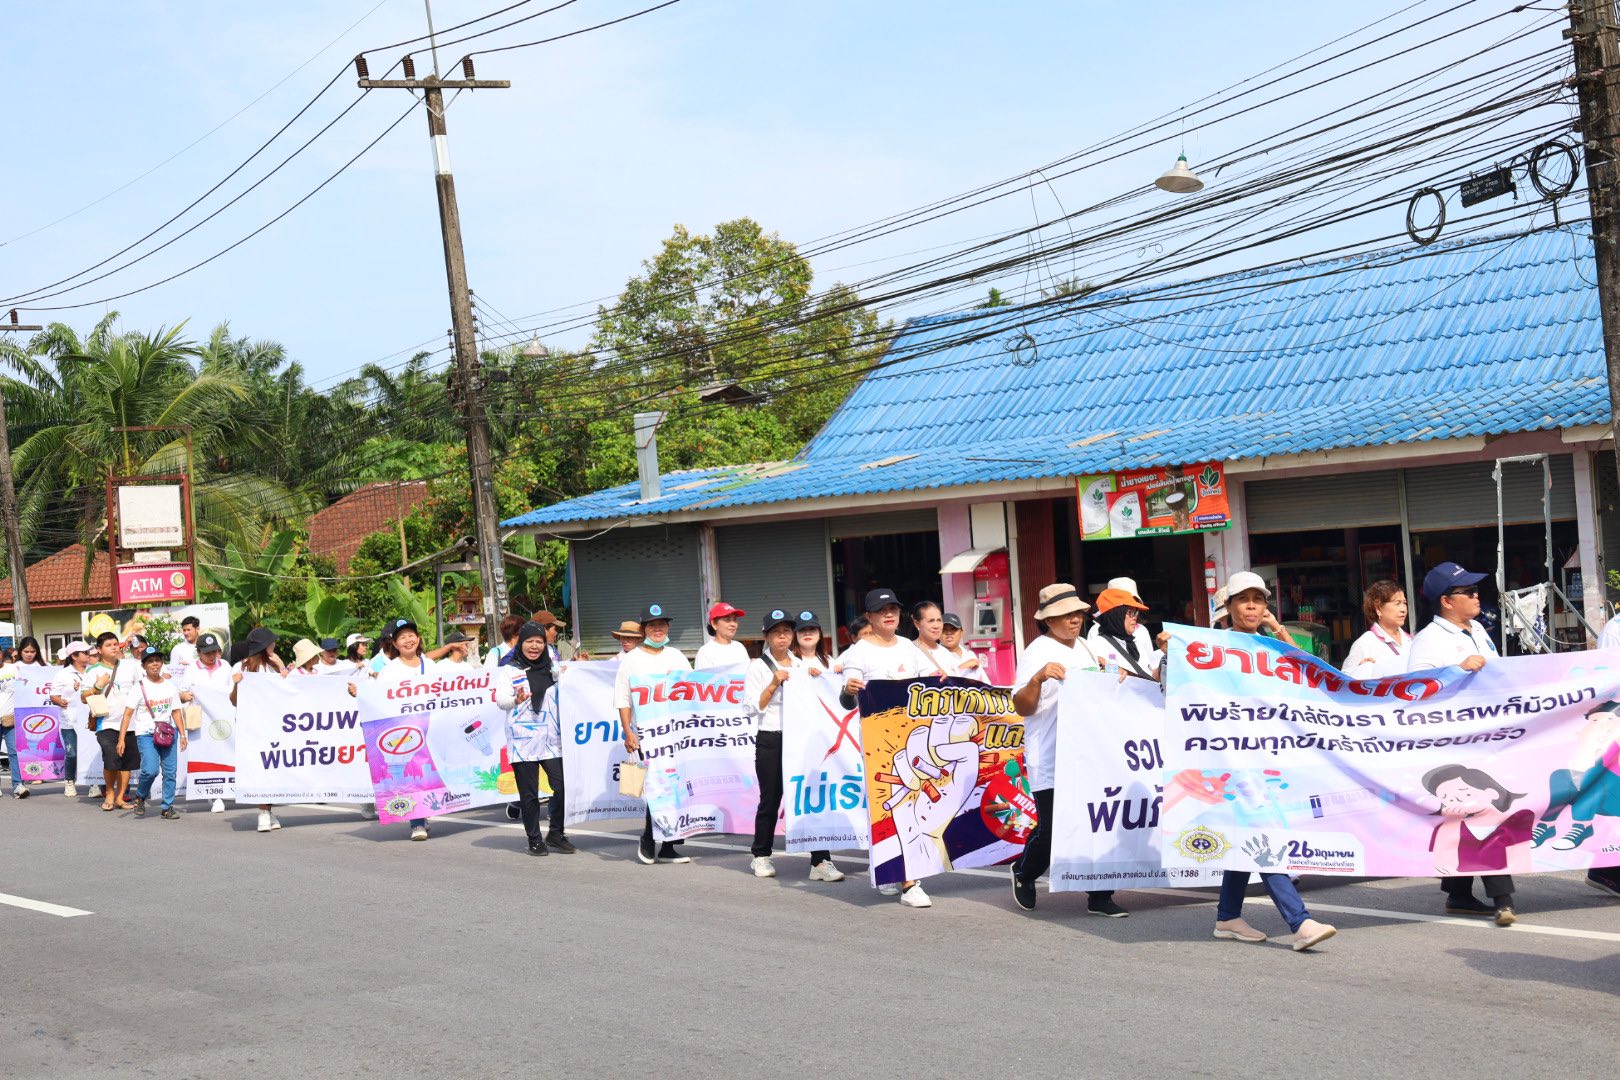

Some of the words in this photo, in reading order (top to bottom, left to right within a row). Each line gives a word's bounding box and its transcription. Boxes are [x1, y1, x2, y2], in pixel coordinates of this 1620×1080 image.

[130, 577, 163, 593] ATM
[386, 673, 490, 700] เด็กรุ่นใหม่
[400, 698, 436, 714] คิดดี
[440, 697, 483, 709] มีราคา
[1181, 702, 1386, 727] พิษร้ายใกล้ตัวเรา
[1393, 686, 1596, 726] ใครเสพก็มัวเมา
[574, 719, 627, 745] ยาเ
[985, 723, 1025, 749] แล
[1185, 726, 1526, 755] ความทุกข์เศร้าถึงครอบครัว
[205, 787, 224, 795] 1386
[790, 764, 868, 816] ไม่เริ่
[1180, 869, 1200, 878] 1386
